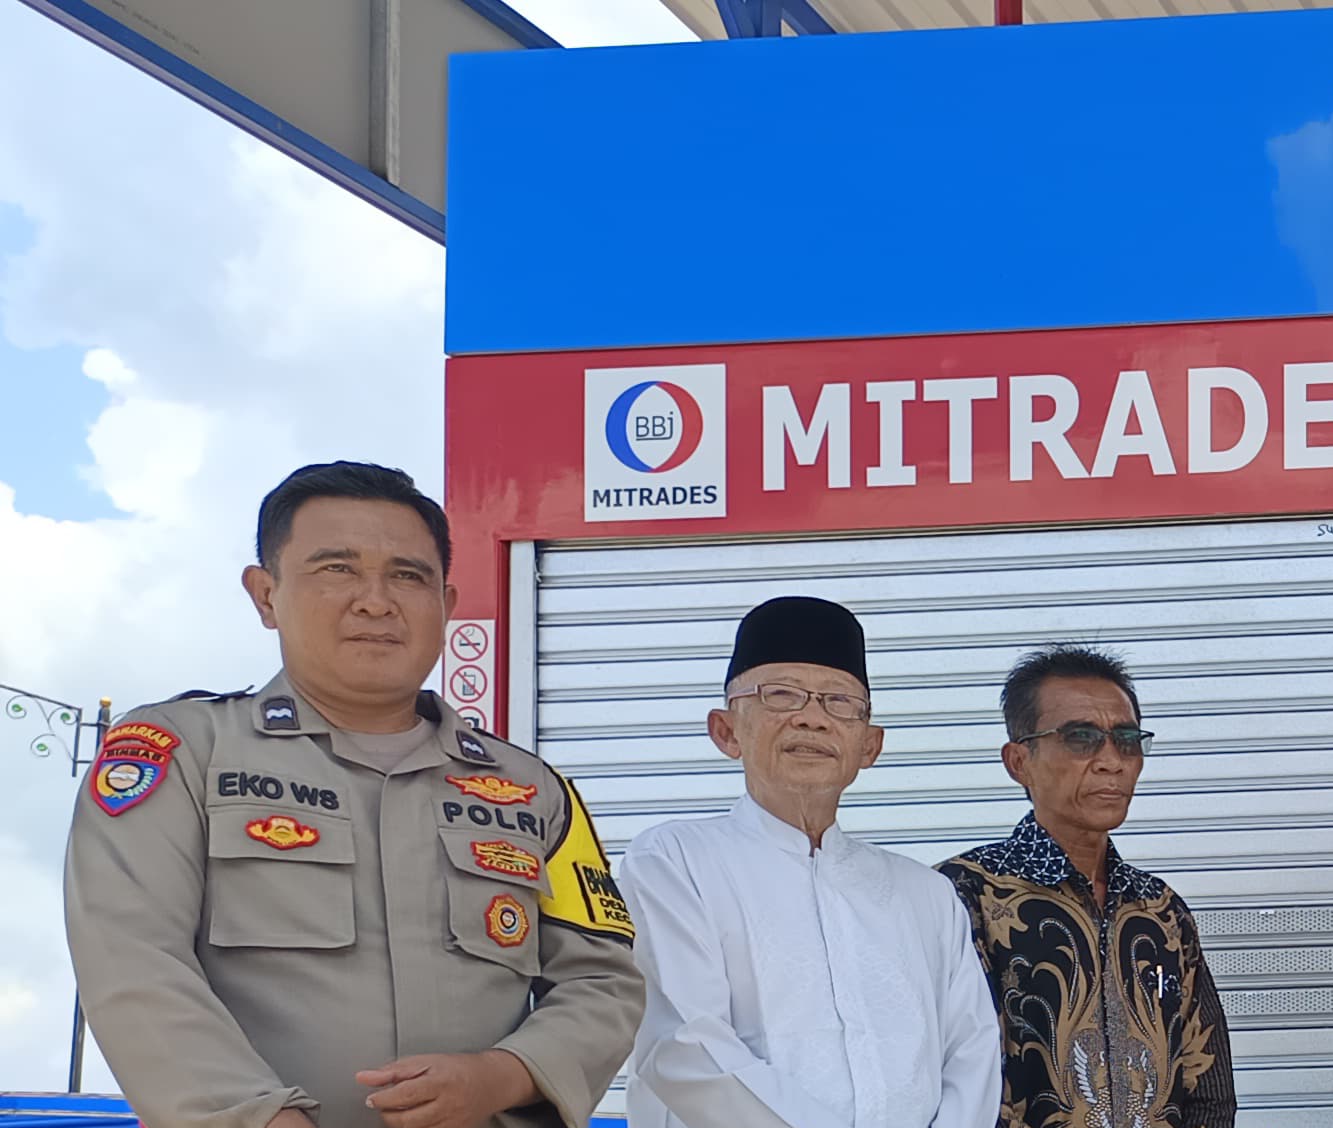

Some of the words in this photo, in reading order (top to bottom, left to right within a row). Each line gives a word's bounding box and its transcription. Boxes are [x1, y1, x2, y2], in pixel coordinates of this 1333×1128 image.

[592, 485, 718, 508] MITRADES
[217, 771, 284, 800] EKO
[290, 781, 340, 810] WS
[442, 801, 546, 841] POLRI
